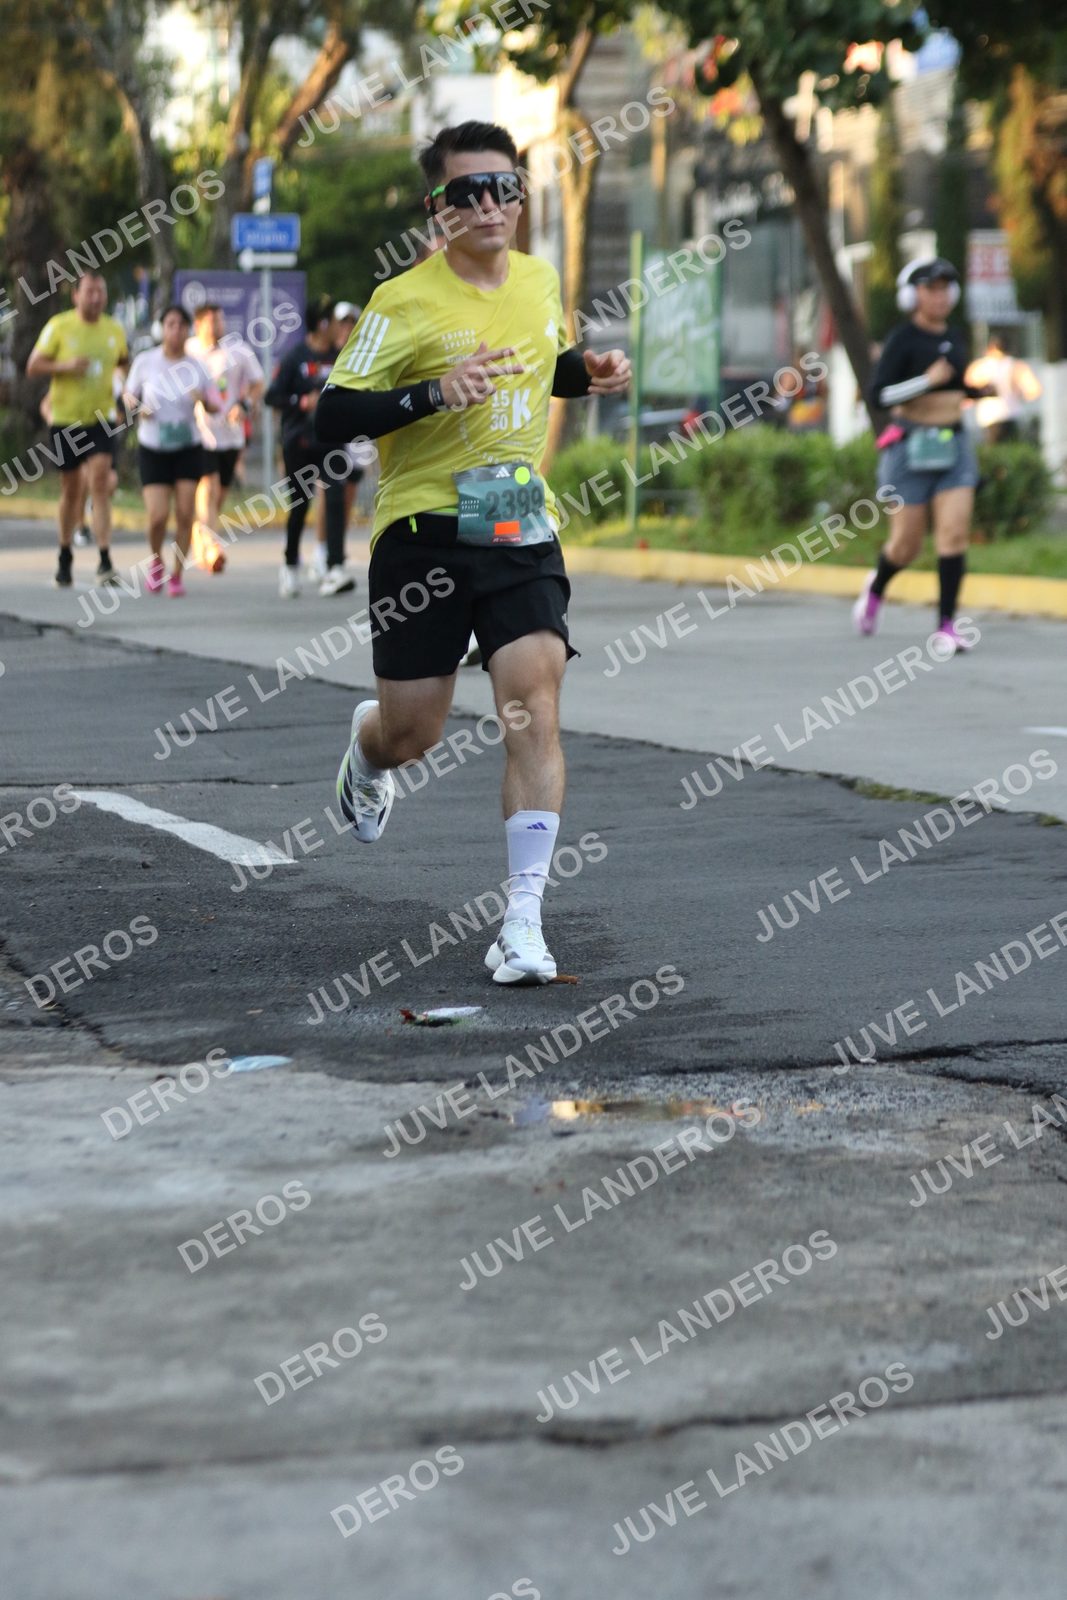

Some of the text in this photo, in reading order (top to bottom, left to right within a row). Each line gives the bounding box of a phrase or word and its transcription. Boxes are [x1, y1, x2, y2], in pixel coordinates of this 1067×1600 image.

[492, 389, 510, 409] 15
[512, 388, 532, 431] K
[490, 413, 508, 432] 30
[485, 486, 543, 521] 2399
